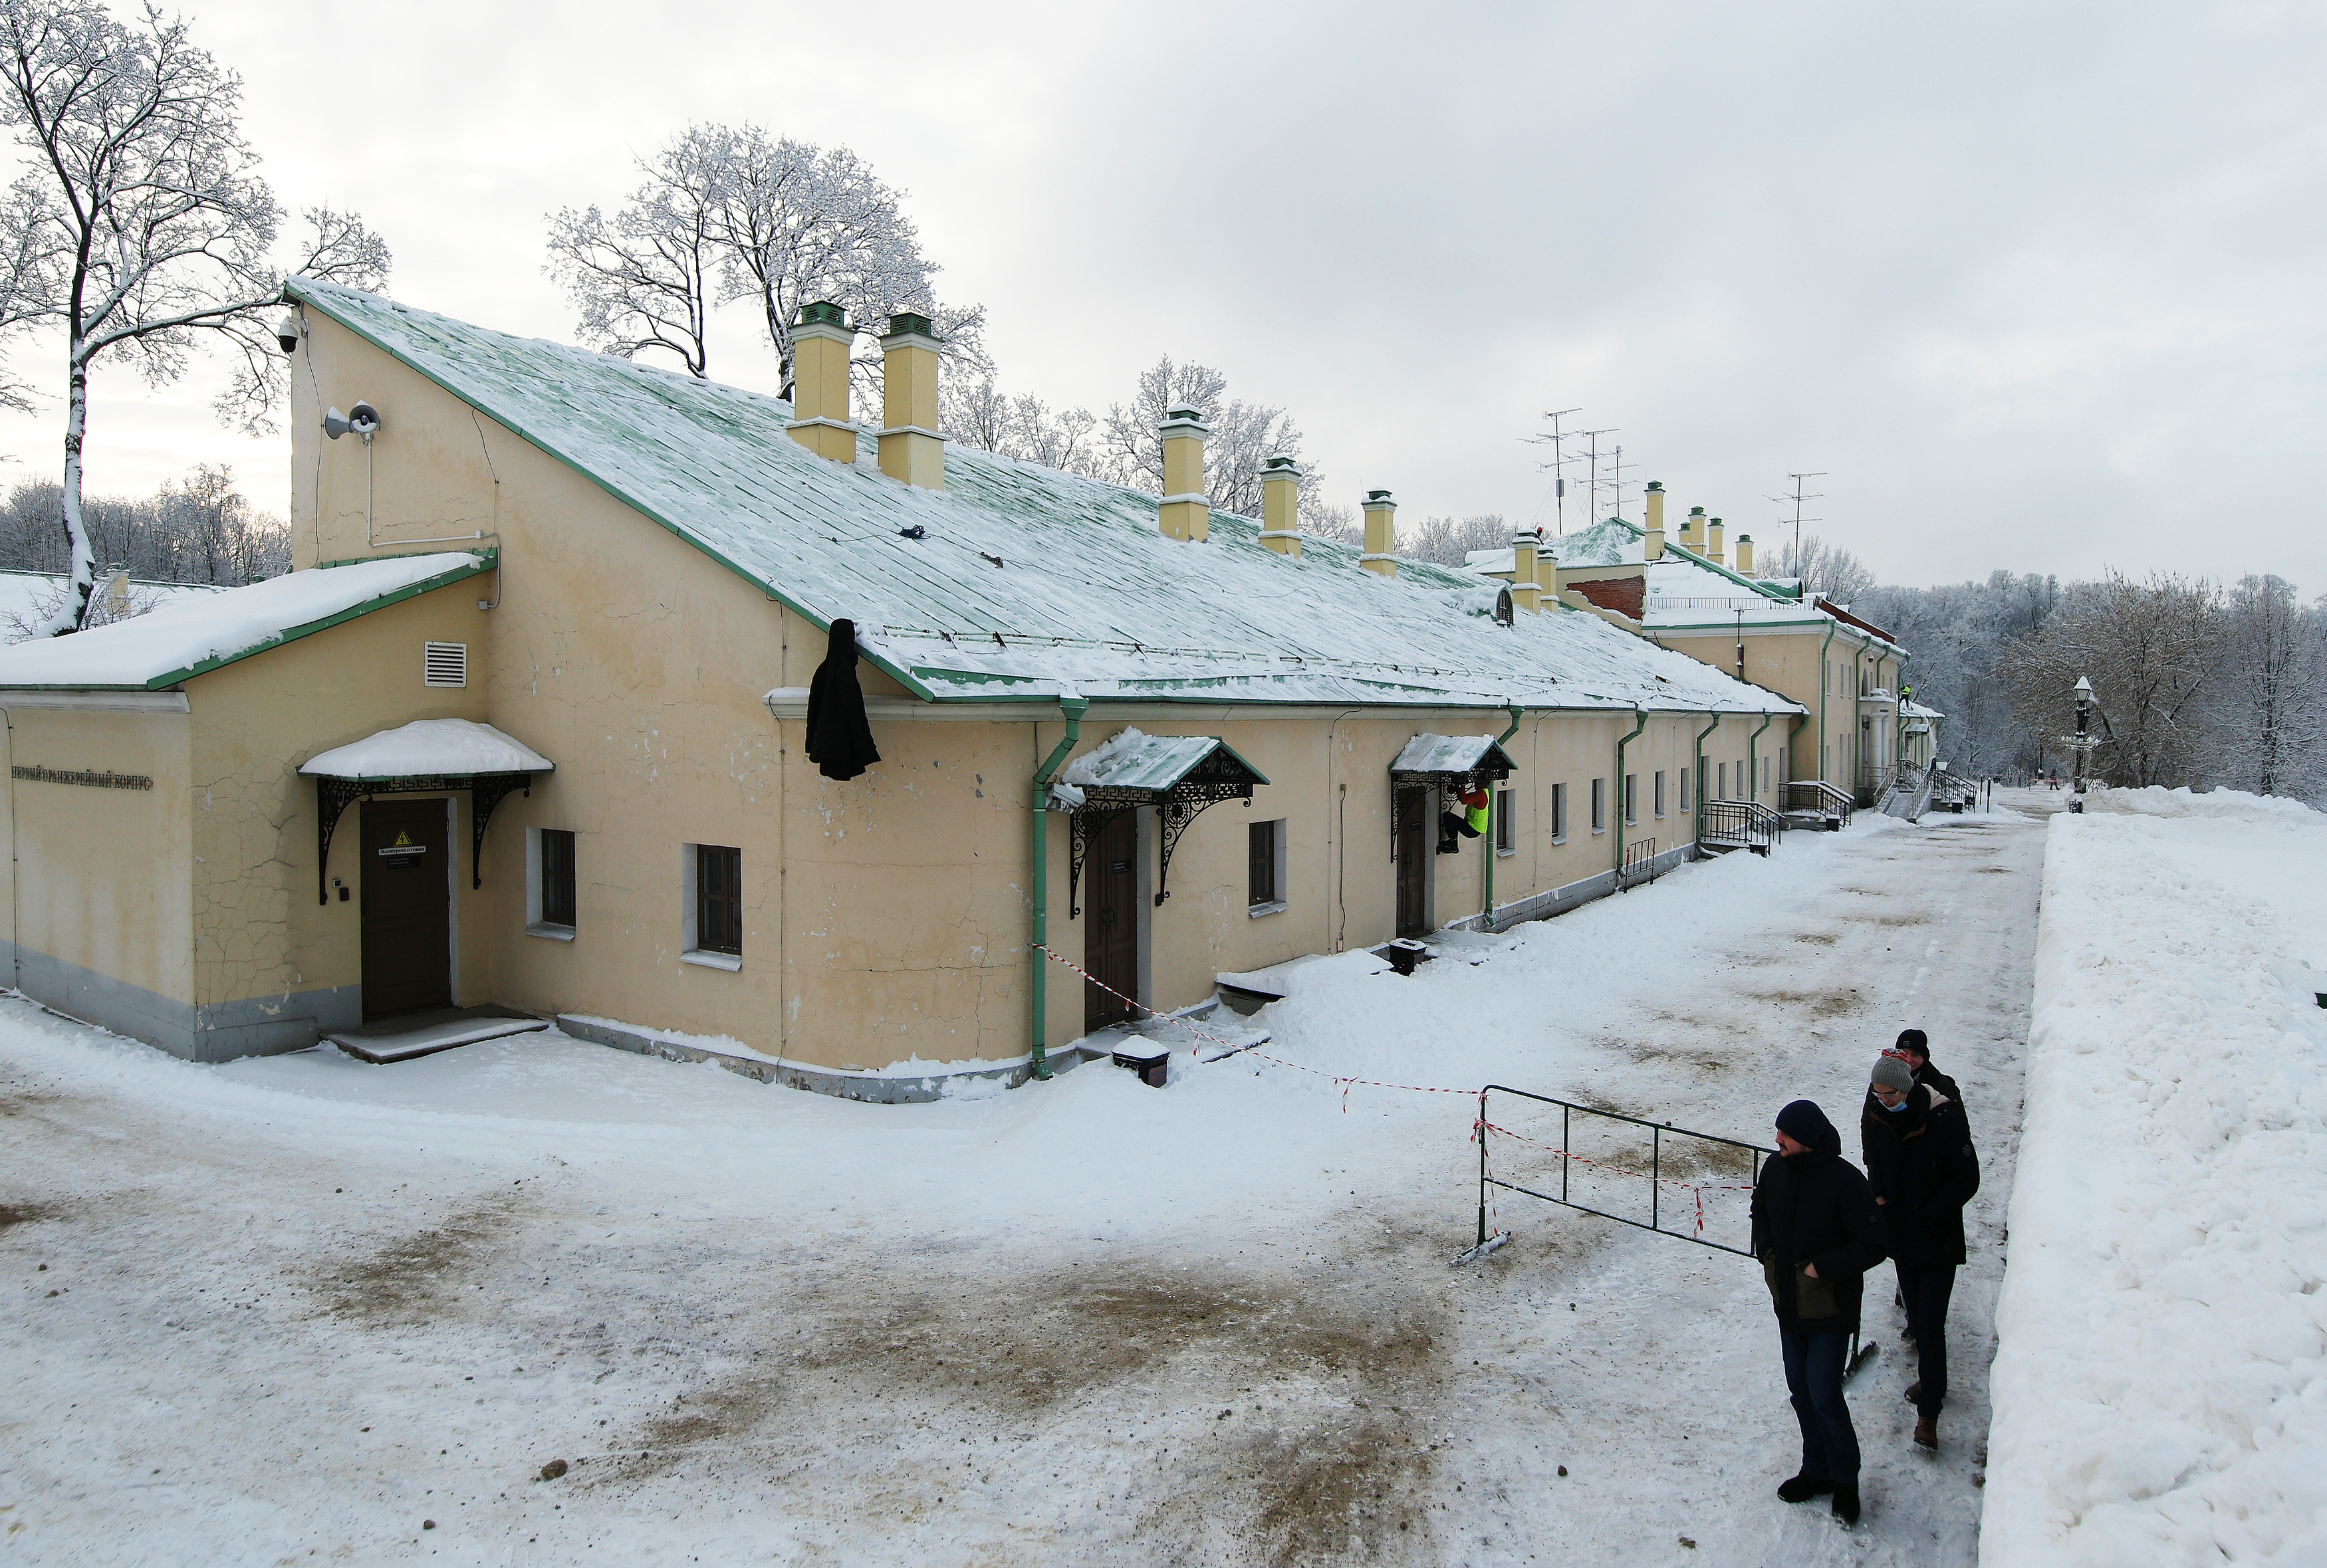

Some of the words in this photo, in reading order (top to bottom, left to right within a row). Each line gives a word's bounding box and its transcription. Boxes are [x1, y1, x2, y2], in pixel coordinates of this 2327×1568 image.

[12, 764, 41, 780] ПЕРВЫЙ
[43, 768, 111, 788] ОРАНЖЕРЕЙНЫЙ
[114, 774, 150, 791] КОРПУС
